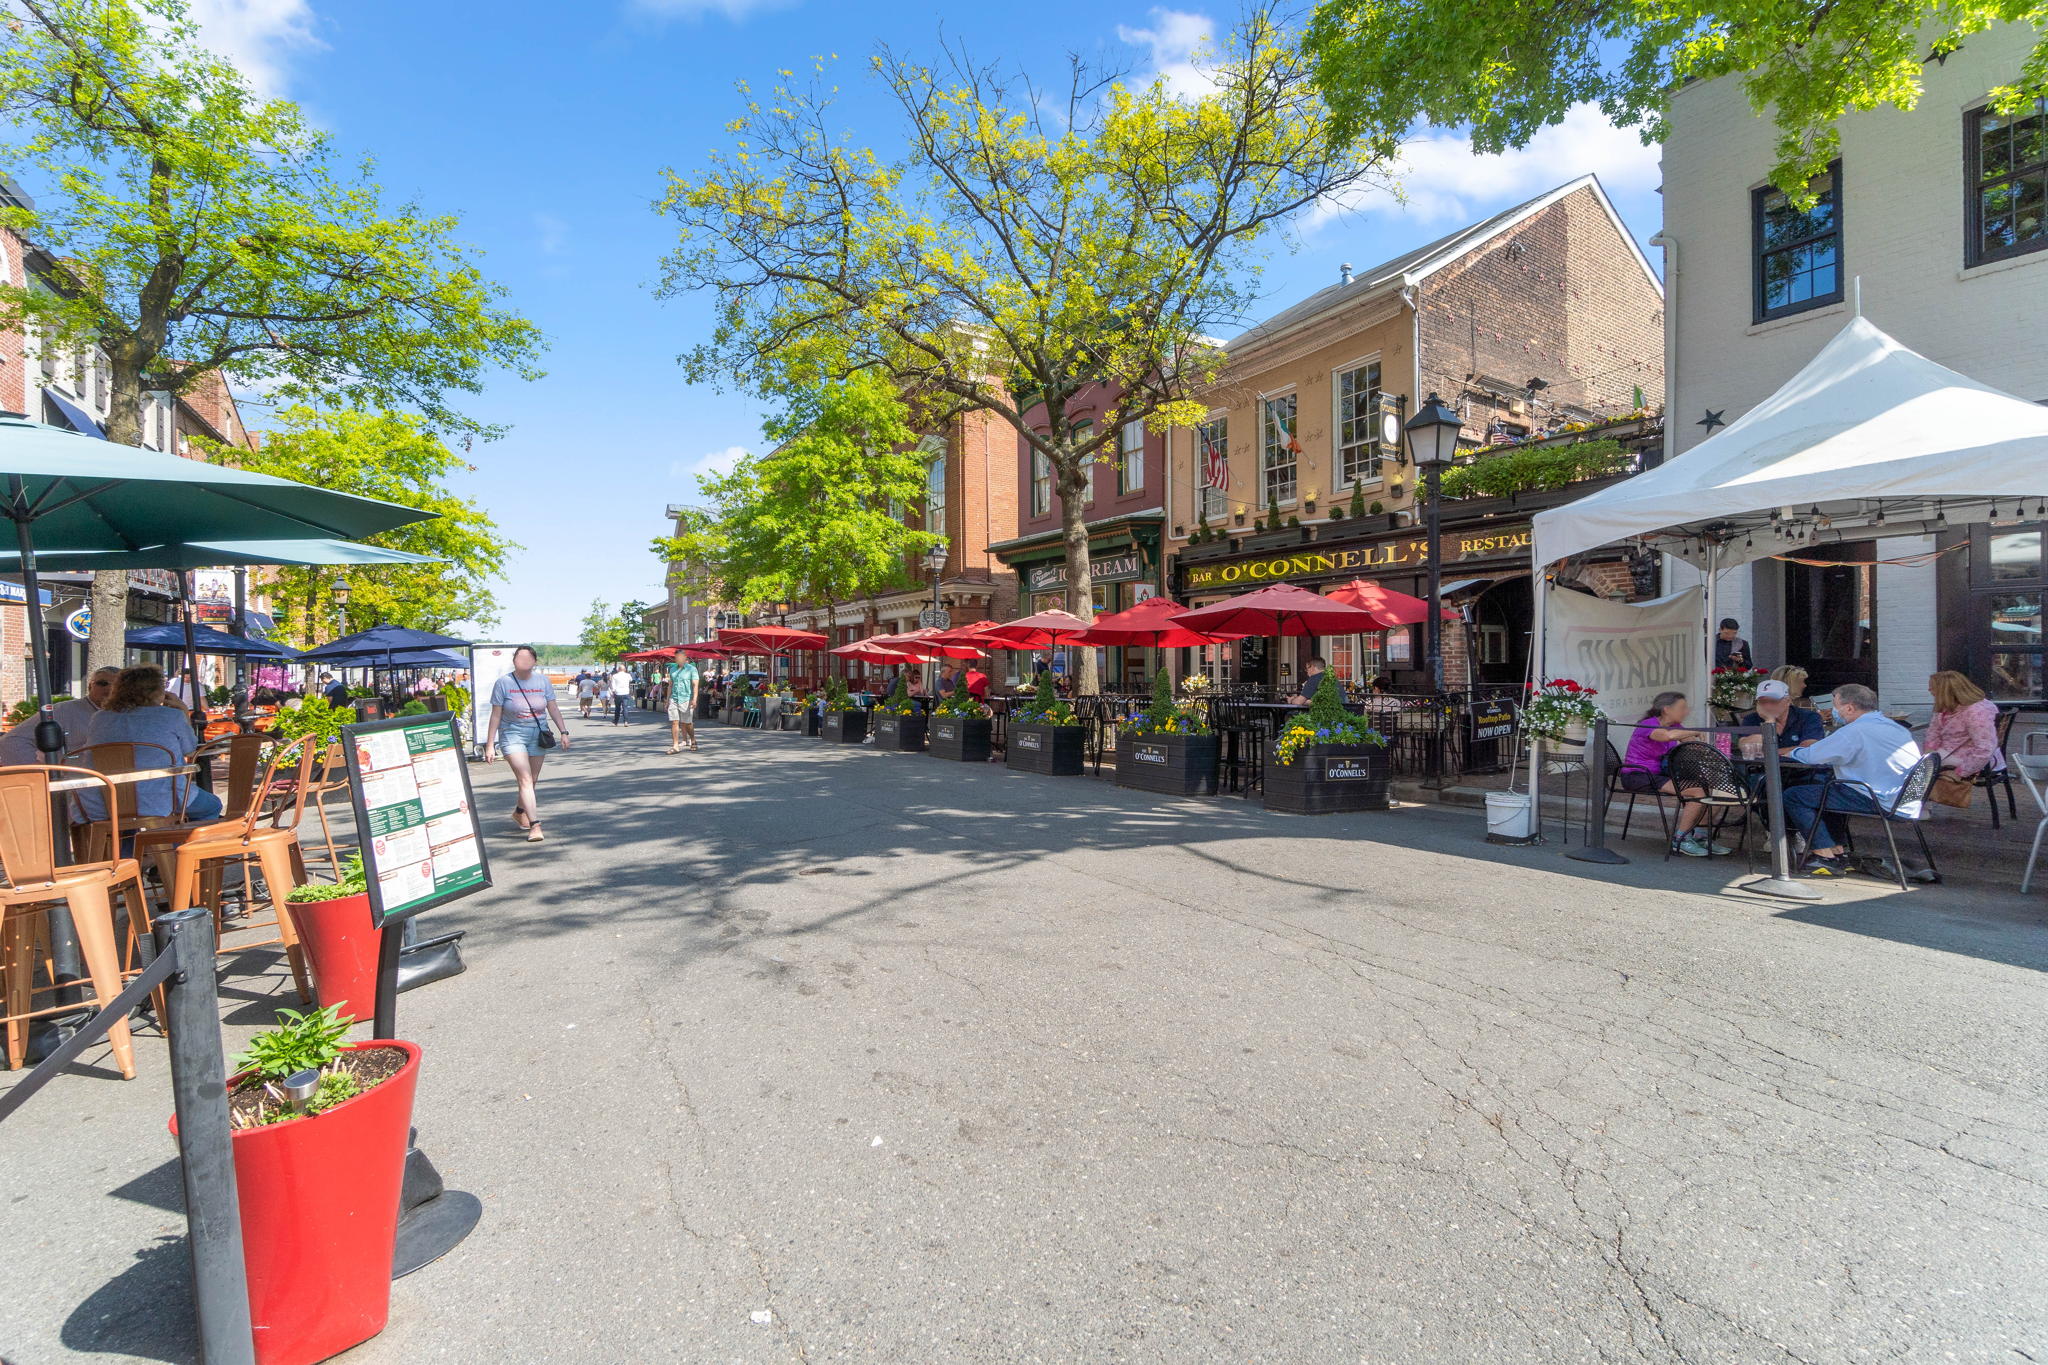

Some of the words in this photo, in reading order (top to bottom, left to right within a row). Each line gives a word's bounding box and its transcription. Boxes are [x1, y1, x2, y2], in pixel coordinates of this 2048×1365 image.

[1460, 533, 1533, 552] RESTAU
[1090, 557, 1137, 577] REAM
[1192, 572, 1212, 583] BAR
[1221, 541, 1429, 581] O'CONNELL'S
[1477, 727, 1494, 739] NOW
[1494, 724, 1511, 736] OPEN
[1329, 769, 1366, 778] O'CONNELL'S
